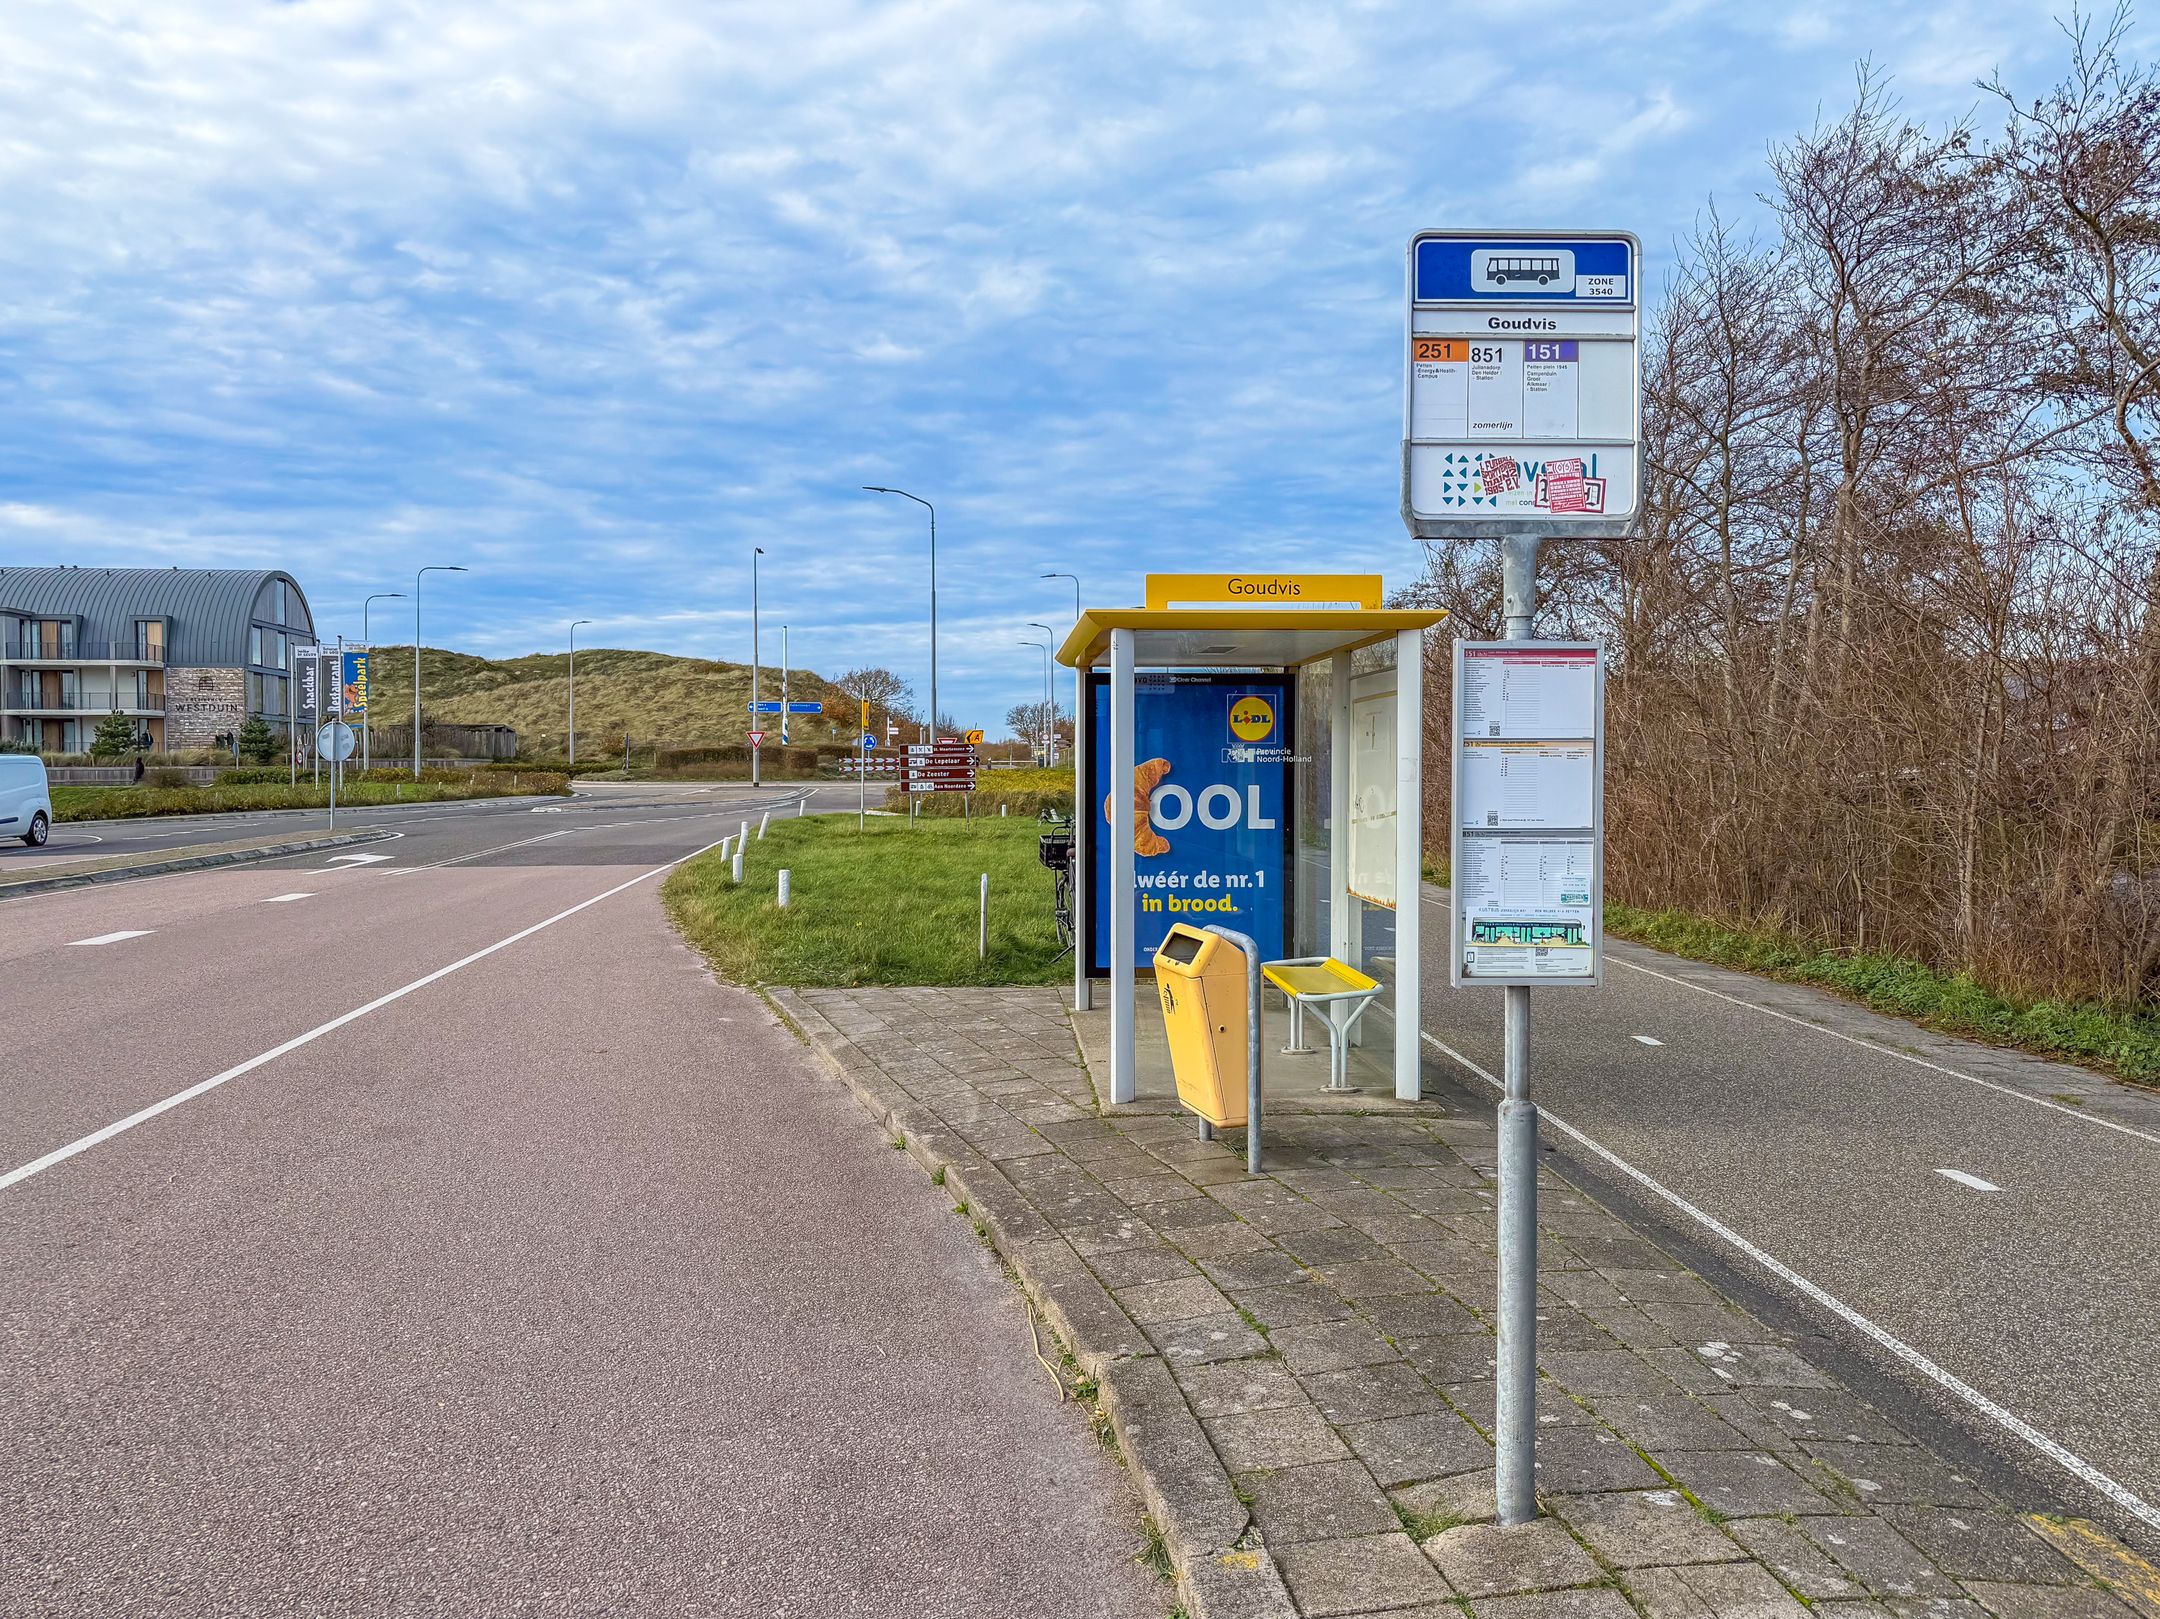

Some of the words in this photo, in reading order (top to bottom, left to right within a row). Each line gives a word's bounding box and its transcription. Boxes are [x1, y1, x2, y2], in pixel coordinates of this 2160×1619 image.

[1588, 277, 1614, 286] ZONE
[1589, 287, 1613, 296] 3540
[1488, 316, 1557, 330] Goudvis
[1418, 343, 1451, 359] 251
[1471, 347, 1503, 363] 851
[1528, 343, 1560, 360] 151
[1472, 421, 1513, 430] zomerlijn
[1227, 578, 1301, 596] Goudvis
[302, 665, 316, 710] Snackbar
[326, 660, 340, 712] Restaurant
[352, 657, 368, 708] Speelpark
[175, 703, 238, 712] WESTDUIN
[1256, 747, 1292, 755] Provincie
[1256, 755, 1312, 763] Noord-Holland
[1193, 870, 1220, 888] de
[1142, 893, 1163, 912] in
[1168, 893, 1238, 912] brood.
